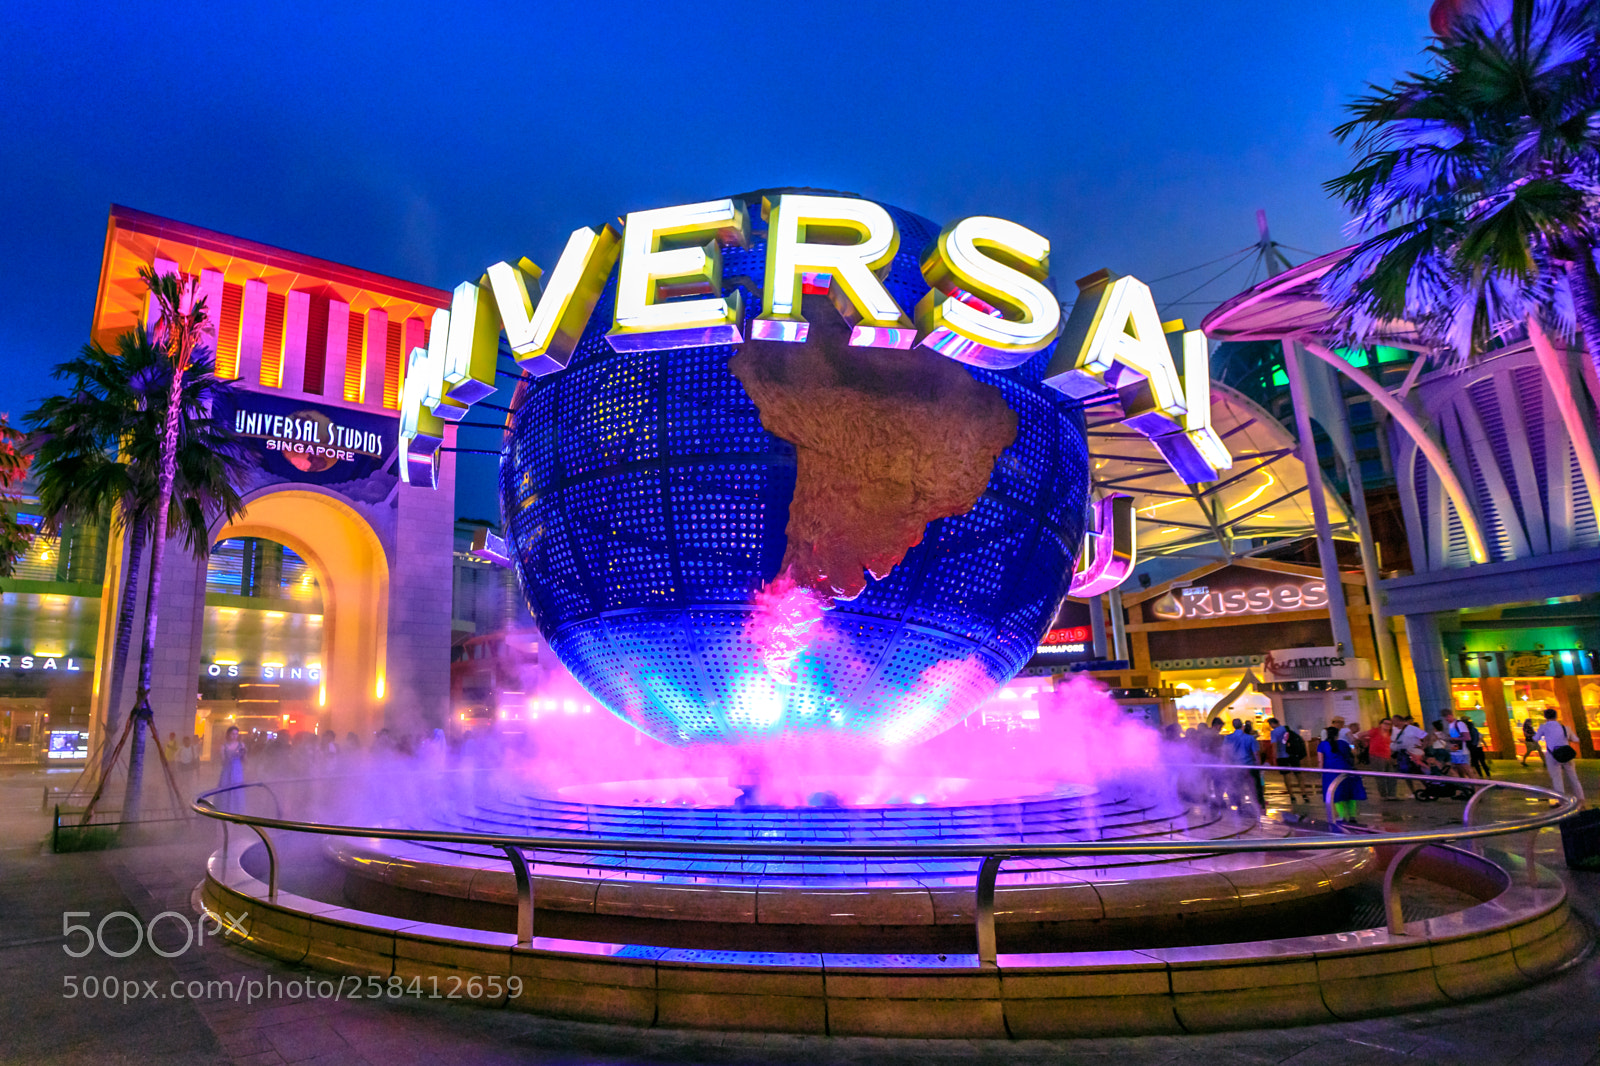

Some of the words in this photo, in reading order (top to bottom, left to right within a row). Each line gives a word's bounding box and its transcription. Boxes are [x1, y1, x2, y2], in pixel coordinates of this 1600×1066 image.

[235, 409, 321, 443] UNIVERSAL
[328, 422, 383, 456] STUDIOS
[266, 439, 355, 462] SINGAPORE
[1042, 626, 1087, 644] ORLD
[0, 655, 80, 671] RSAL
[208, 664, 239, 677] OS
[264, 666, 320, 680] SING
